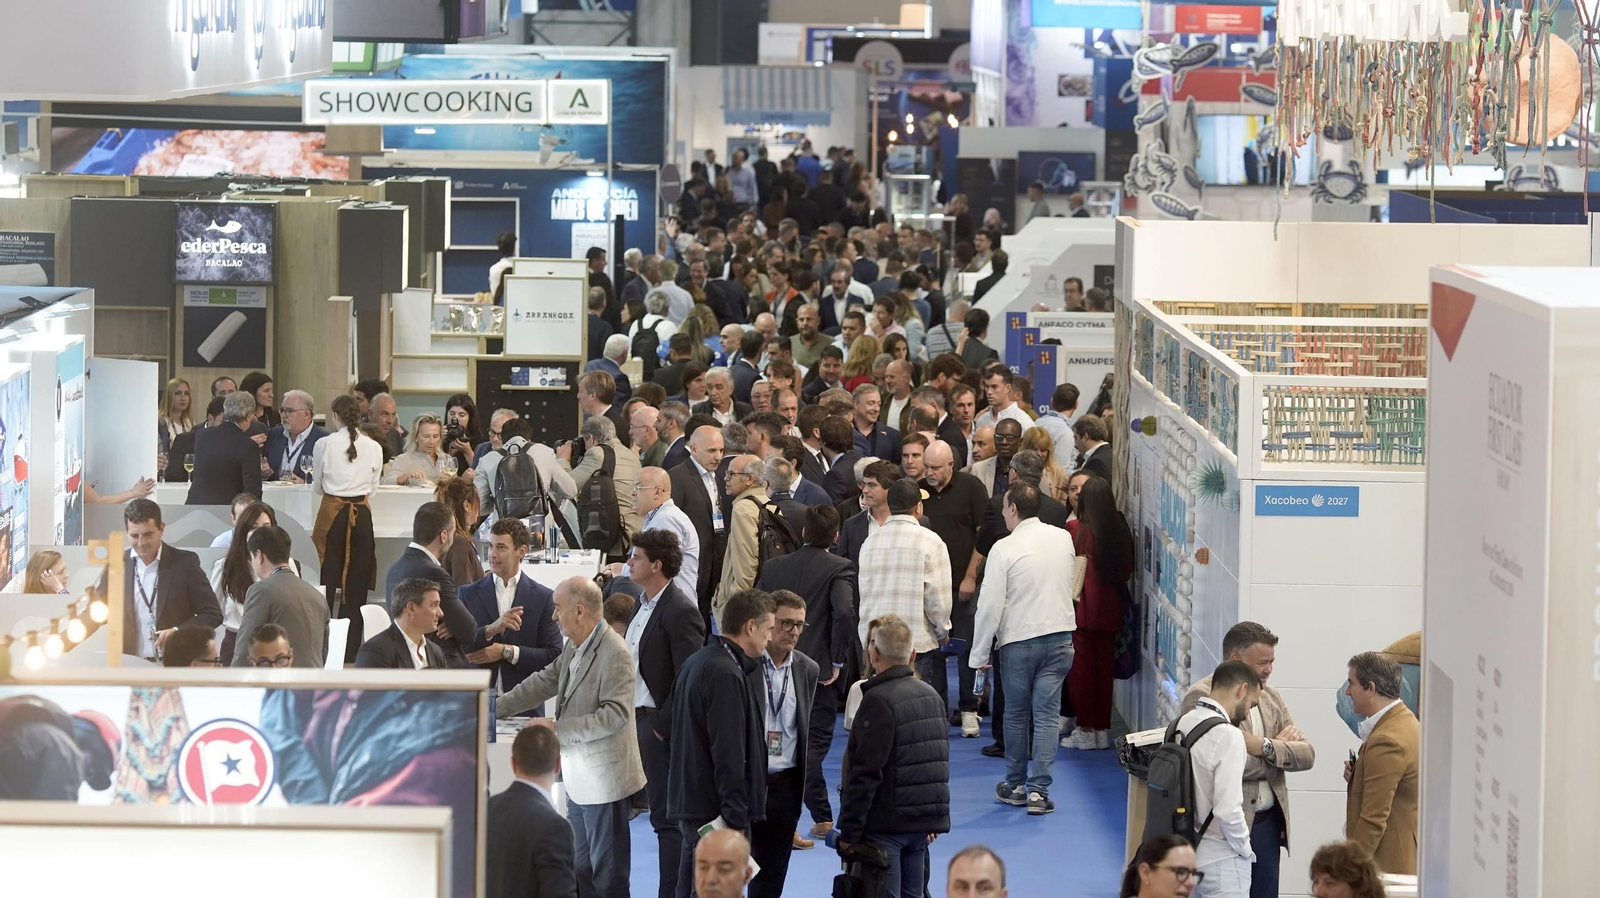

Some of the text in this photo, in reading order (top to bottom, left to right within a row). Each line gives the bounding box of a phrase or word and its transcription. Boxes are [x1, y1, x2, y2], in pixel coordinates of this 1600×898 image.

[862, 59, 895, 76] SLS
[319, 90, 532, 113] SHOWCOOKING
[181, 238, 267, 254] ederPesca
[205, 259, 243, 267] BACALAO
[1038, 404, 1050, 414] 01
[1264, 495, 1349, 506] Xacobeo 2027
